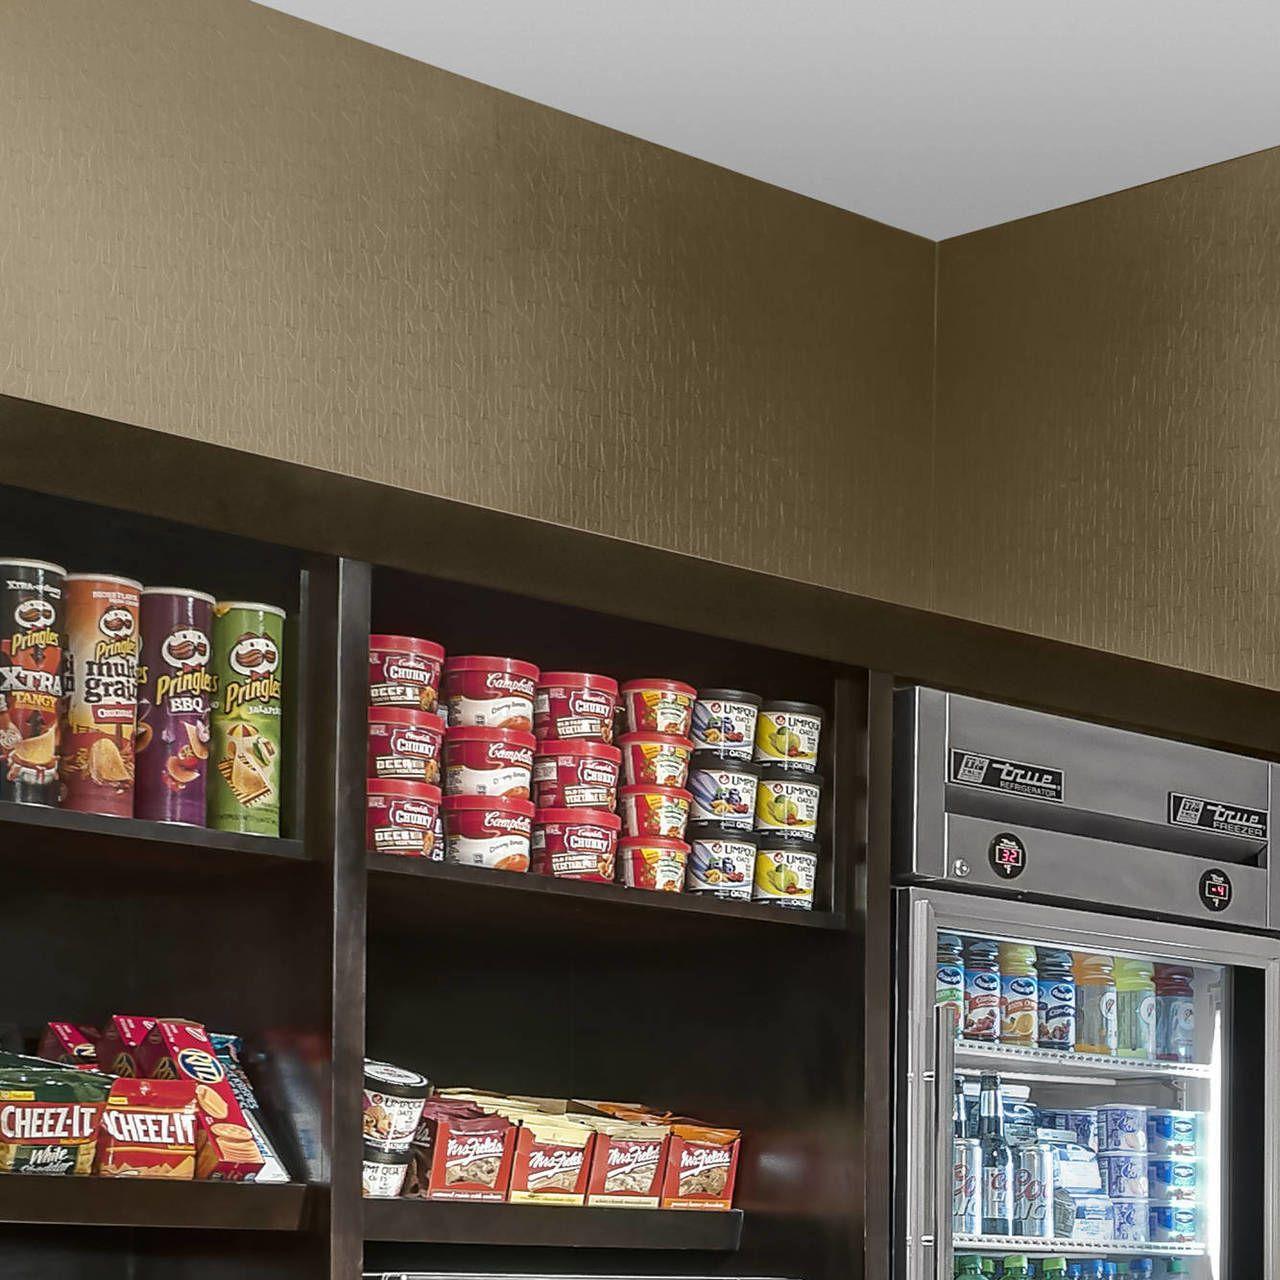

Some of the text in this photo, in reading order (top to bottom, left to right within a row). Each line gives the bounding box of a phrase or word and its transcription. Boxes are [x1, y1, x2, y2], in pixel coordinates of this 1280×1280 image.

[390, 666, 432, 684] CHUNKY
[155, 667, 219, 705] Pringles
[170, 697, 204, 713] BBQ
[396, 739, 435, 756] CHUNKY
[992, 763, 1061, 791] true
[1000, 781, 1057, 797] REFRIGERATOR
[395, 810, 433, 828] CHUNKY
[1206, 804, 1266, 830] true
[1213, 821, 1263, 837] FREEZER
[1002, 849, 1018, 863] 32
[1211, 885, 1225, 896] -4
[180, 1050, 223, 1082] RITZ
[1, 1105, 97, 1139] CHEEZ-IT
[107, 1110, 197, 1145] CHEEZ-IT
[30, 1145, 69, 1165] White
